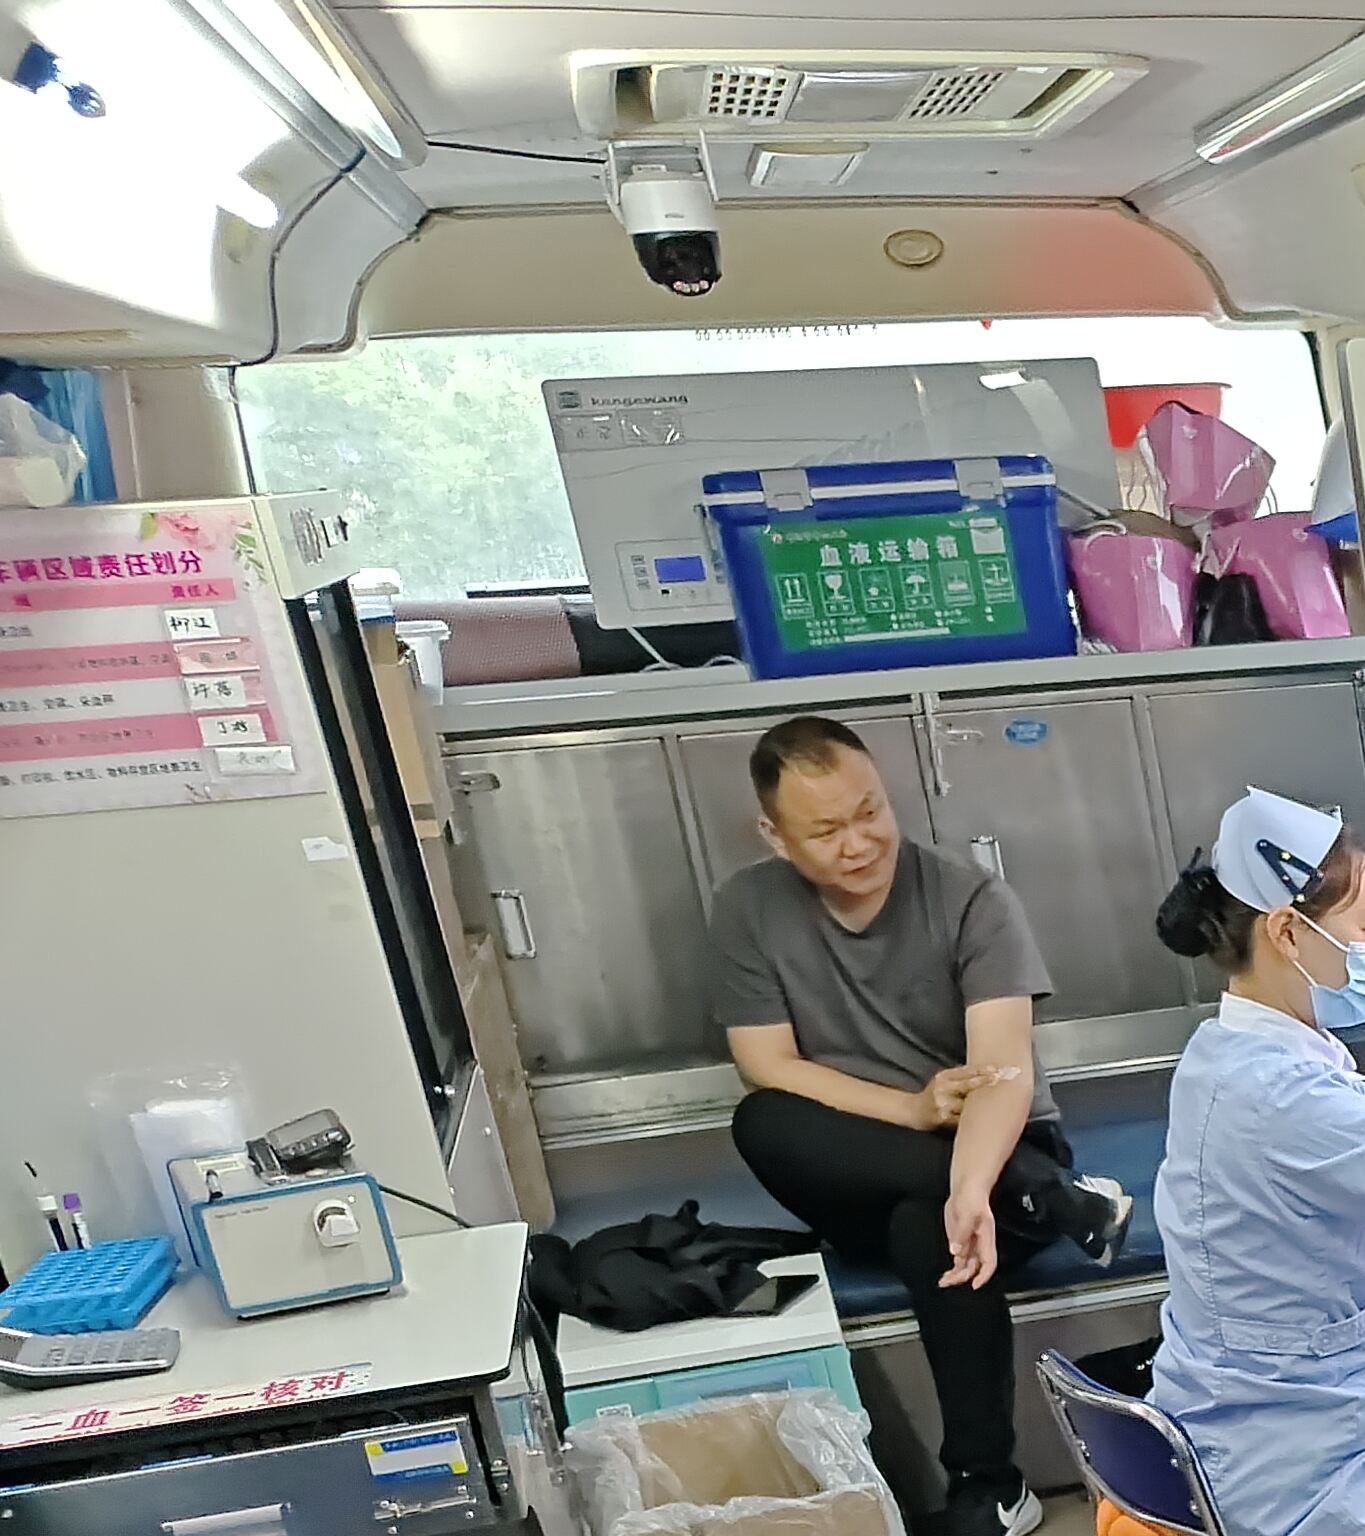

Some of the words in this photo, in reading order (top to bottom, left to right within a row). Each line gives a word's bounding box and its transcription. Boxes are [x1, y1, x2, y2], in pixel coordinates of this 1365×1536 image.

[819, 534, 959, 567] 血液运输箱
